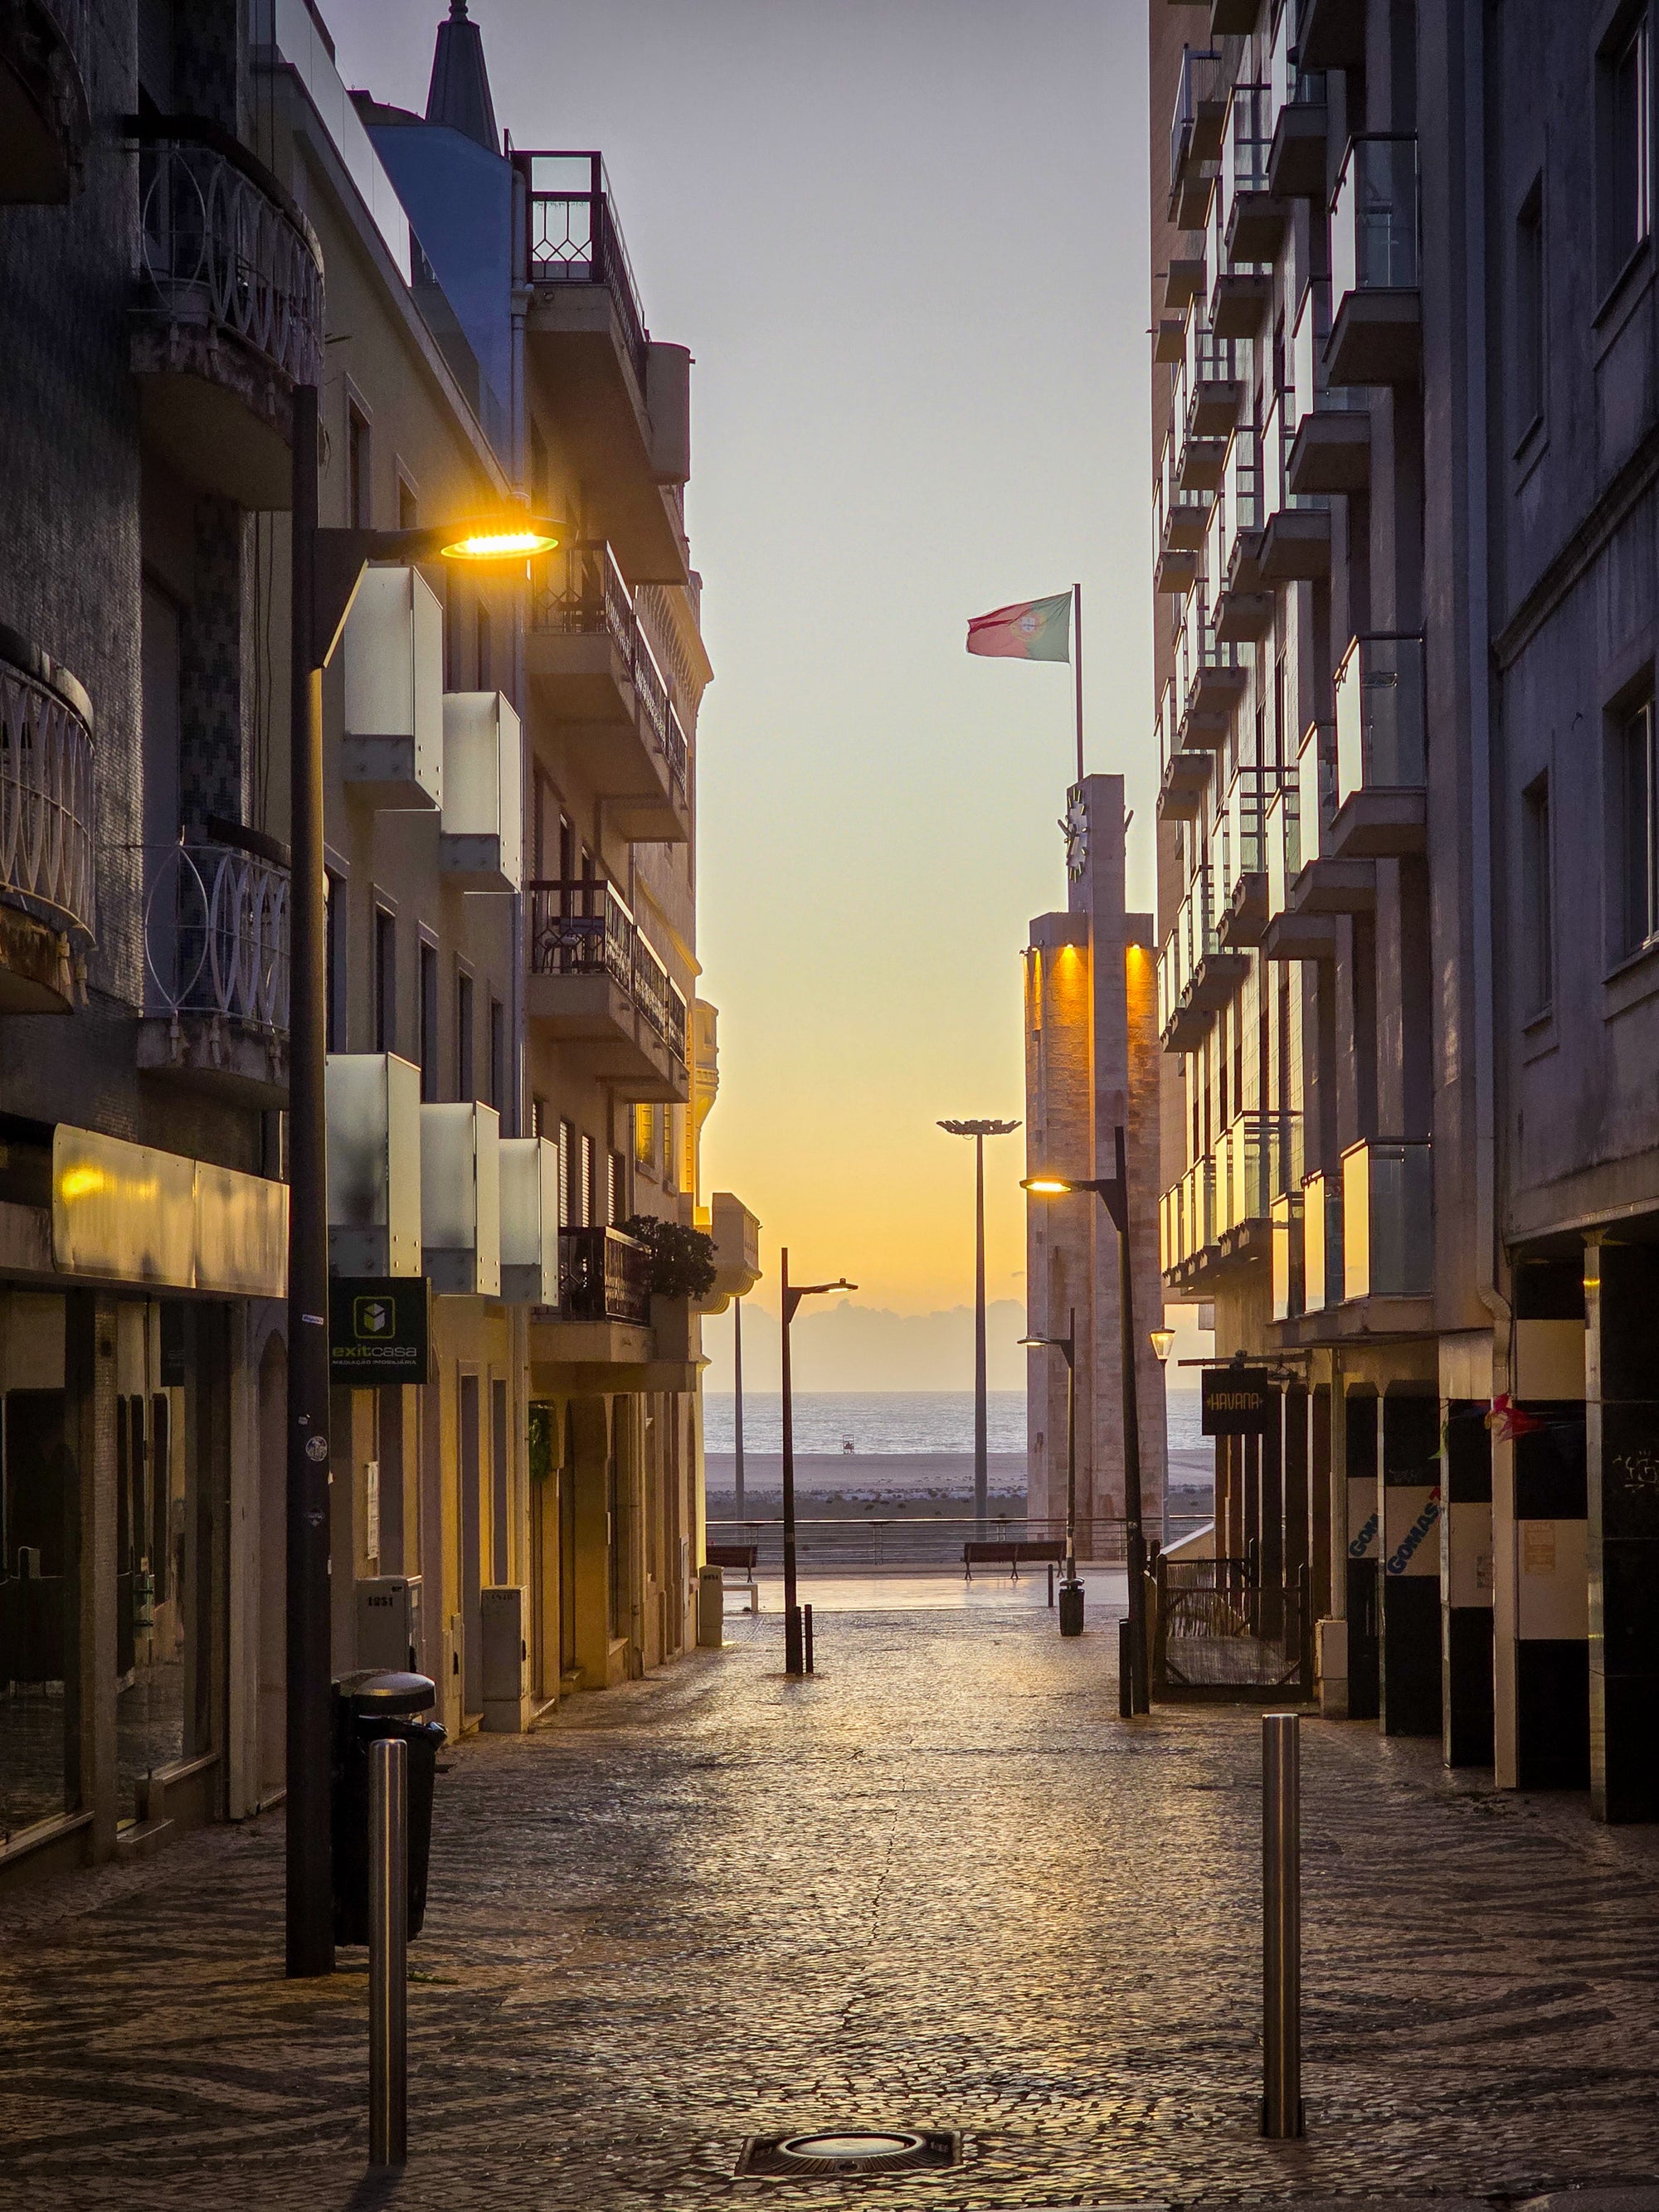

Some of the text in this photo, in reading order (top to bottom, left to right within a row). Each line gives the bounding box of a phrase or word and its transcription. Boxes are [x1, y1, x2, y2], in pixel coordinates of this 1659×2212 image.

[333, 1344, 417, 1357] exitcasa
[1211, 1393, 1259, 1410] HAVANA
[1387, 1502, 1438, 1574] GOMAS
